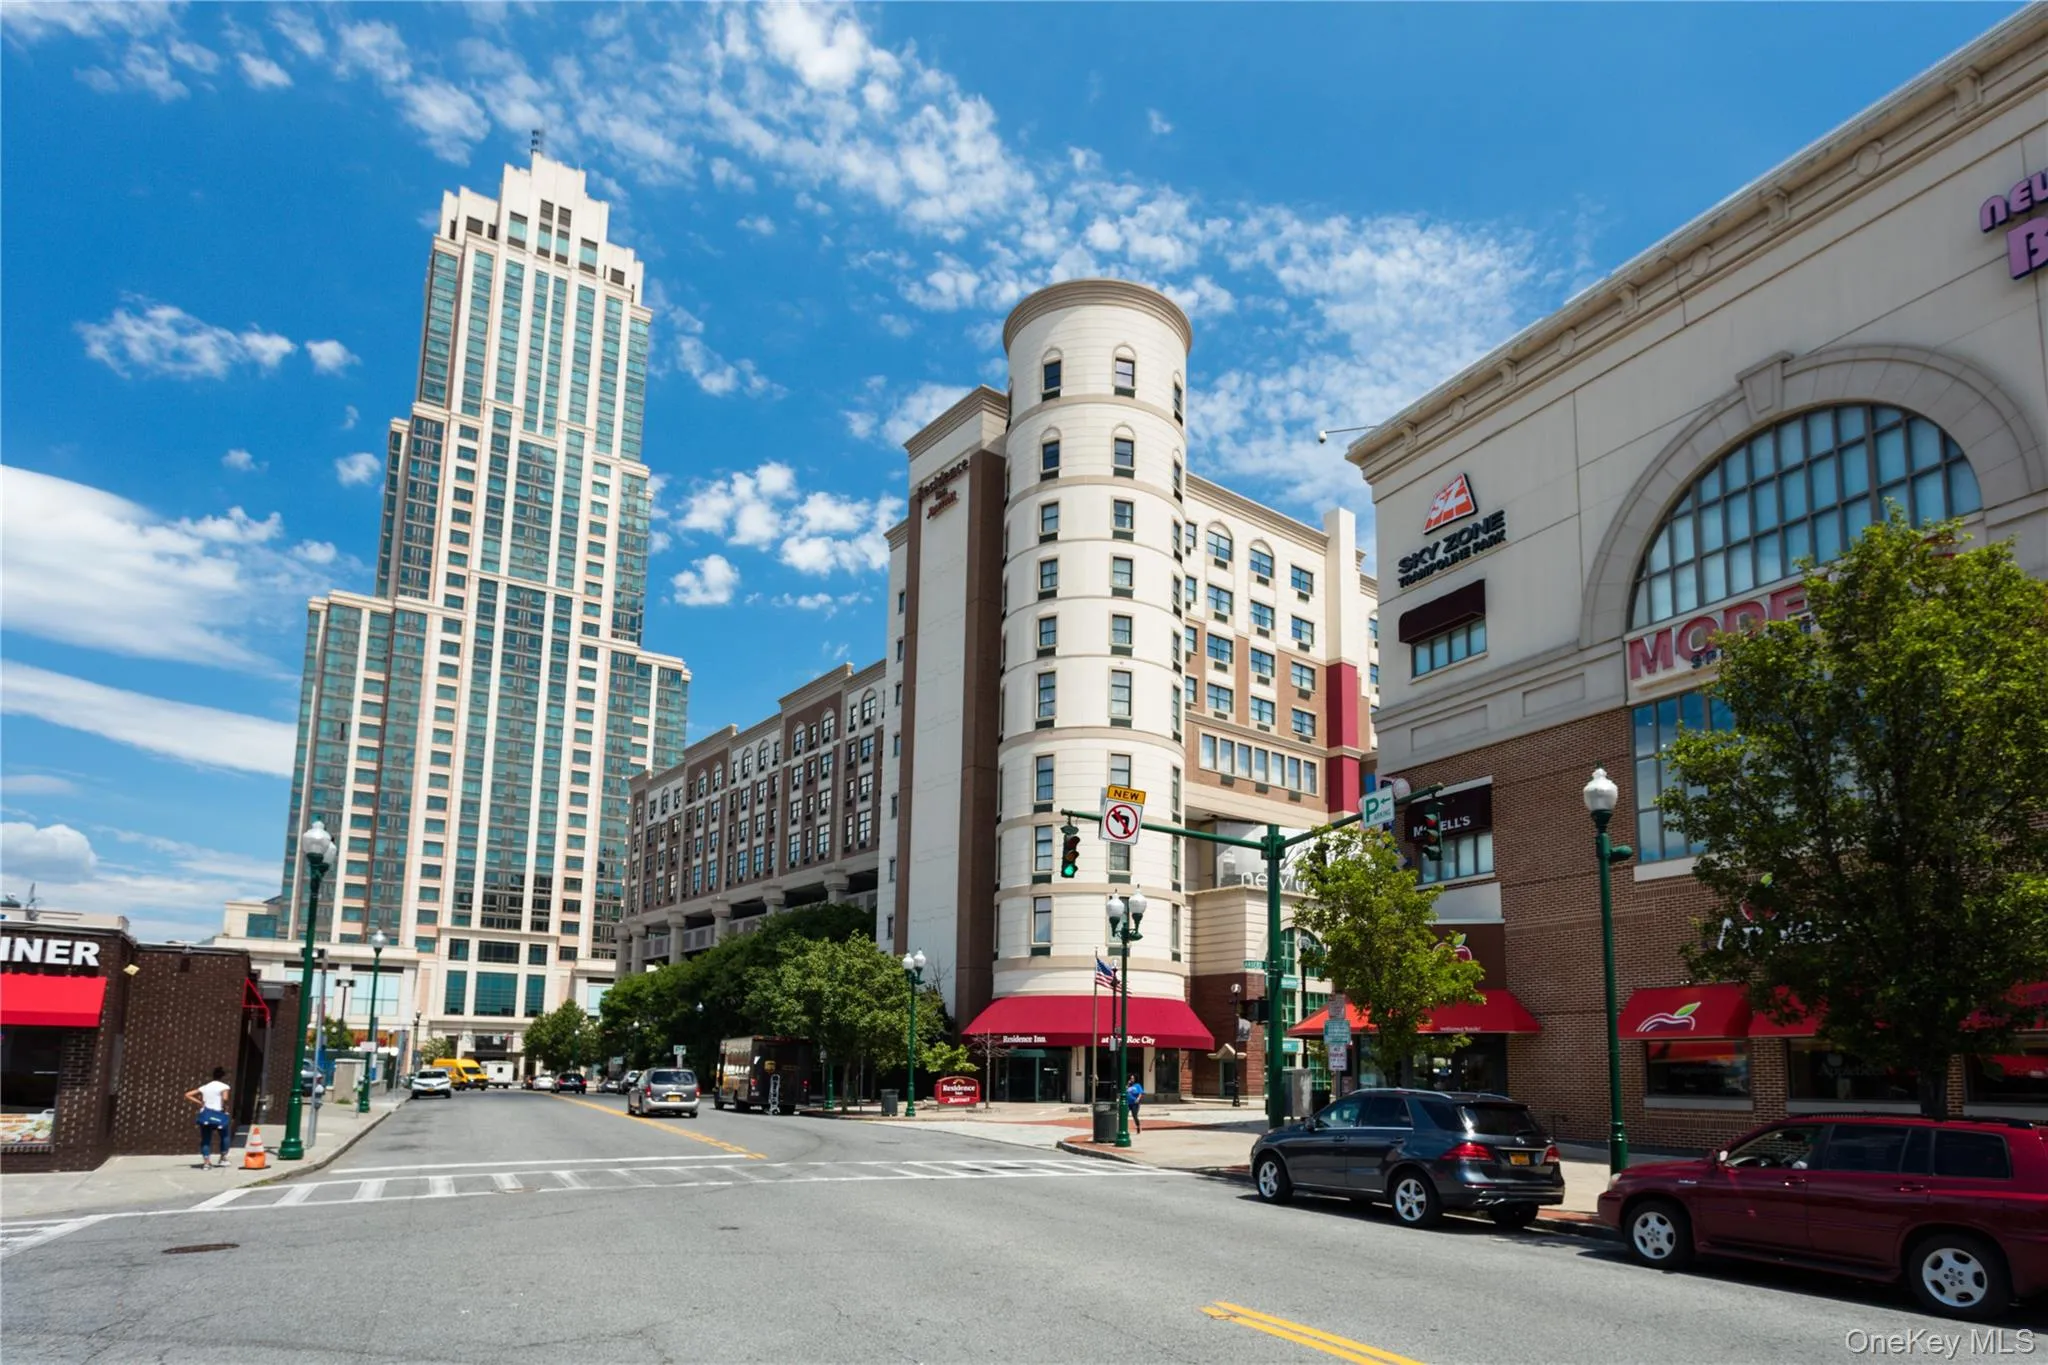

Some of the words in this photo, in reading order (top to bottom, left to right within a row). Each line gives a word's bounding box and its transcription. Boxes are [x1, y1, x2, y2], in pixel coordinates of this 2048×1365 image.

[1398, 541, 1441, 574] SKY
[1442, 509, 1505, 554] ZONE
[1397, 545, 1472, 588] TRAMPOLINE
[1472, 528, 1506, 554] PARK
[1113, 789, 1140, 801] NEW
[1003, 1035, 1033, 1043] Residence
[1127, 1036, 1141, 1044] Roc
[1141, 1036, 1156, 1046] City
[942, 1084, 976, 1092] Residence
